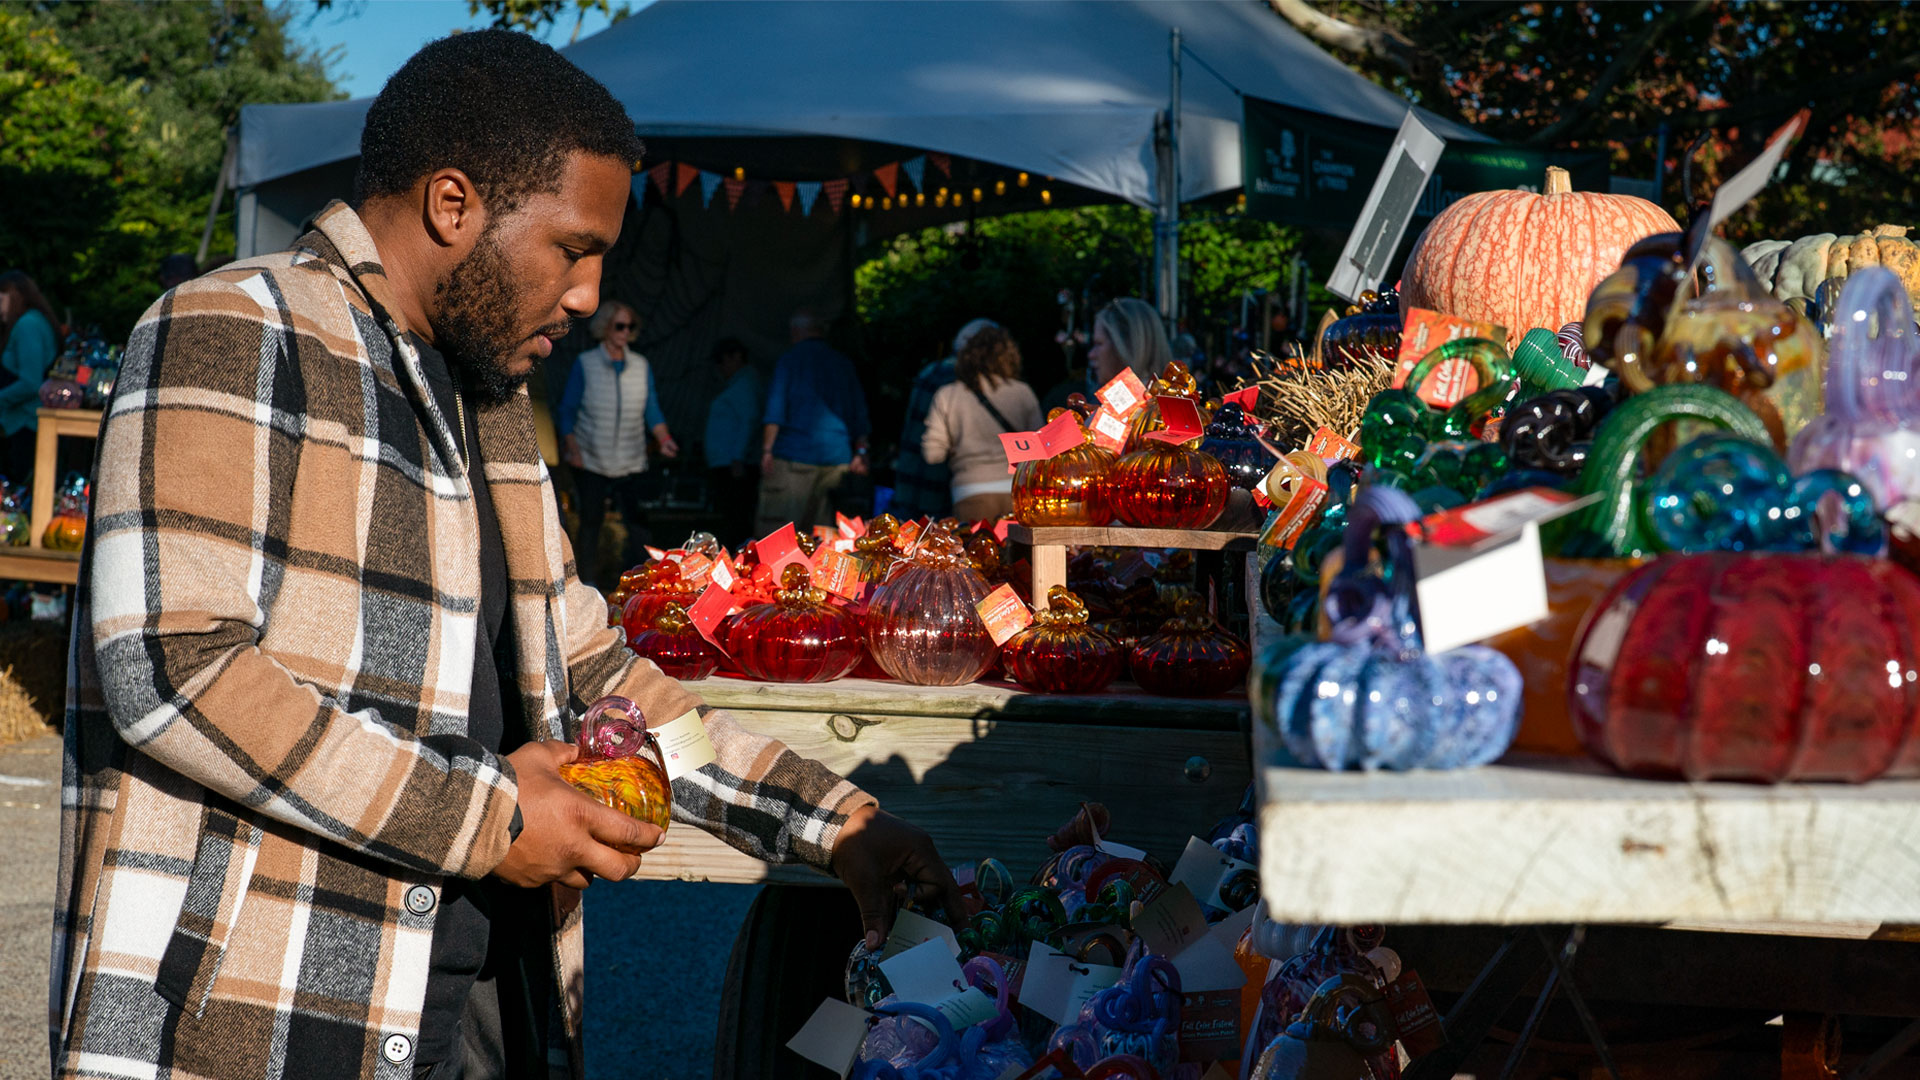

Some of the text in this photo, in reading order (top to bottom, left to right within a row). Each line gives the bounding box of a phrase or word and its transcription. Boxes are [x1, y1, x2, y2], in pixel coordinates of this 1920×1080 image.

[1015, 440, 1030, 451] U
[1182, 1019, 1235, 1031] Fall Color Festival
